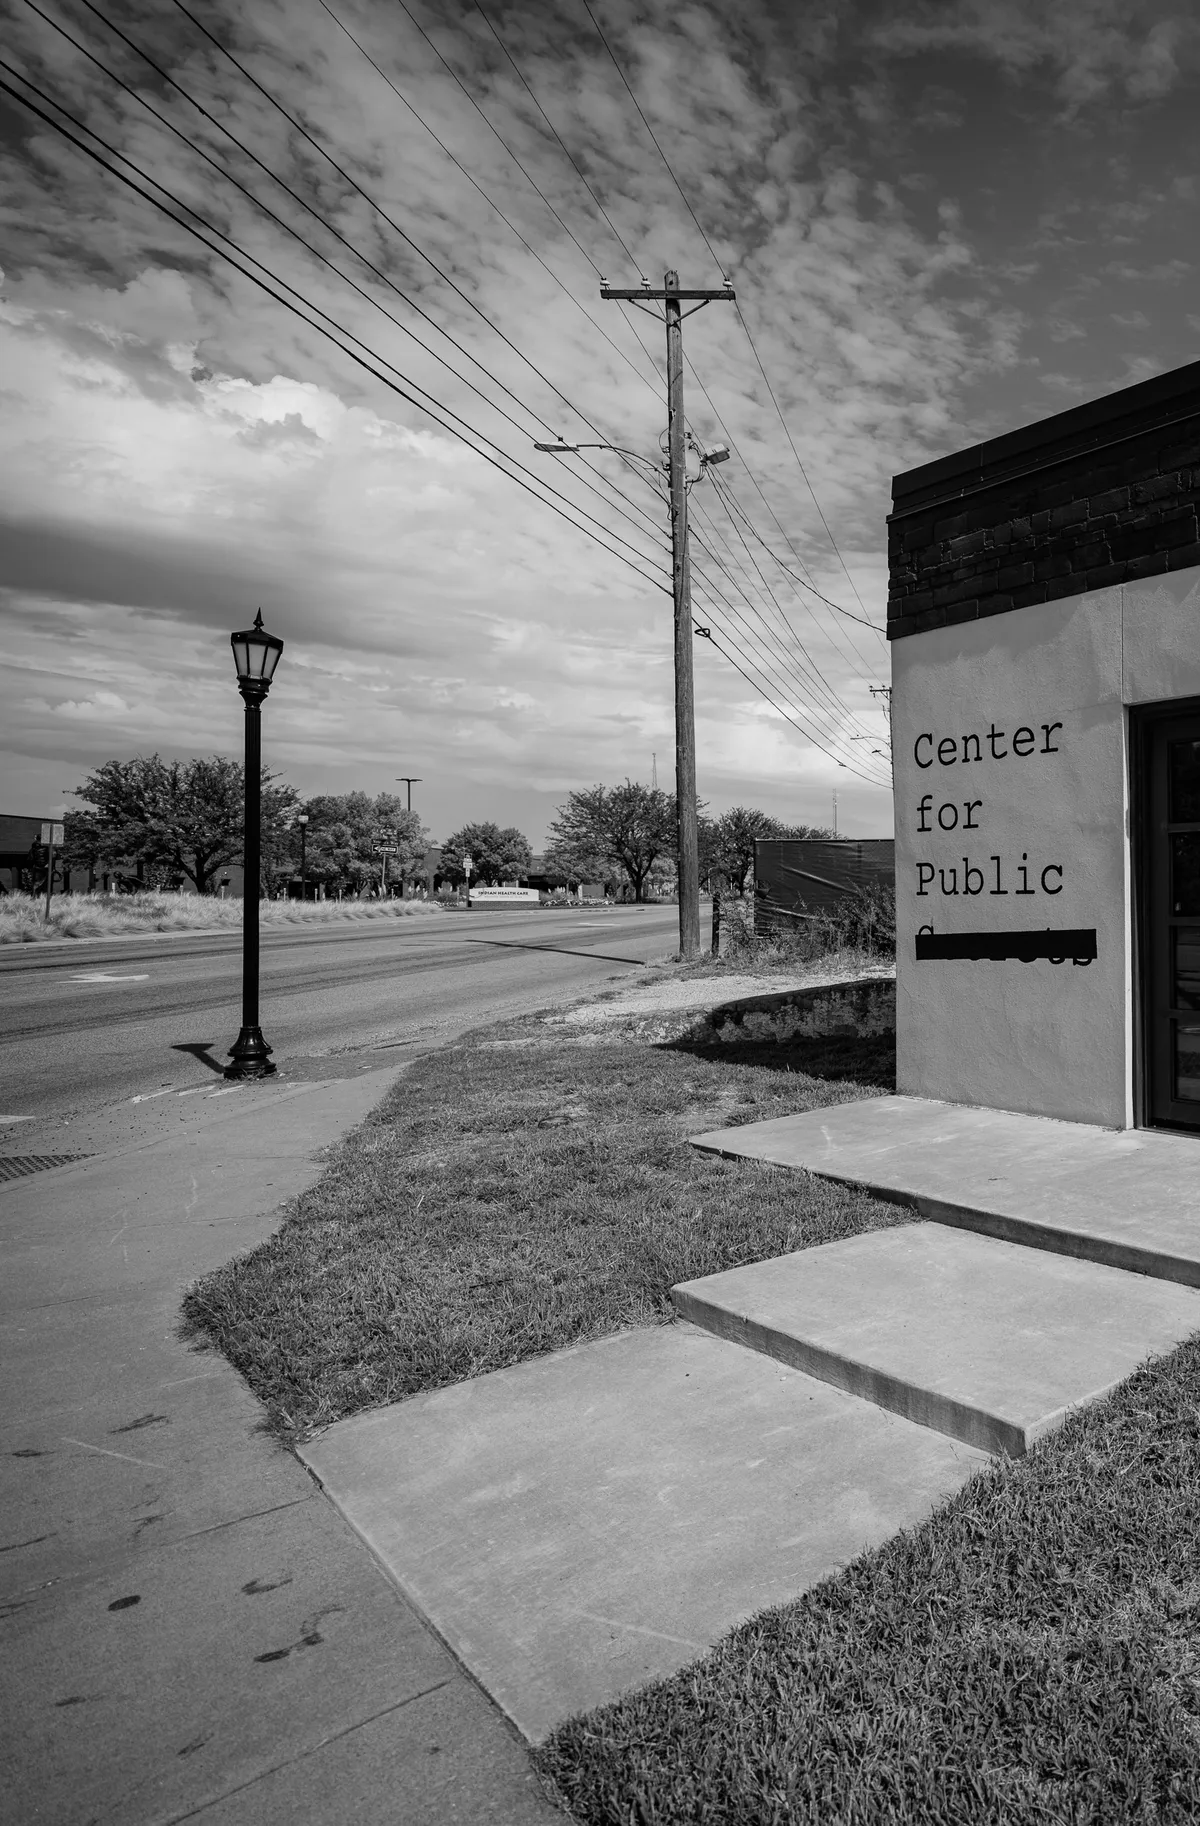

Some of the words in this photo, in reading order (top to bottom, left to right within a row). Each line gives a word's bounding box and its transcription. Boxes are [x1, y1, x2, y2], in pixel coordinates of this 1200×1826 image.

[914, 722, 1063, 768] Center
[916, 795, 983, 832] for
[916, 853, 1063, 896] Public
